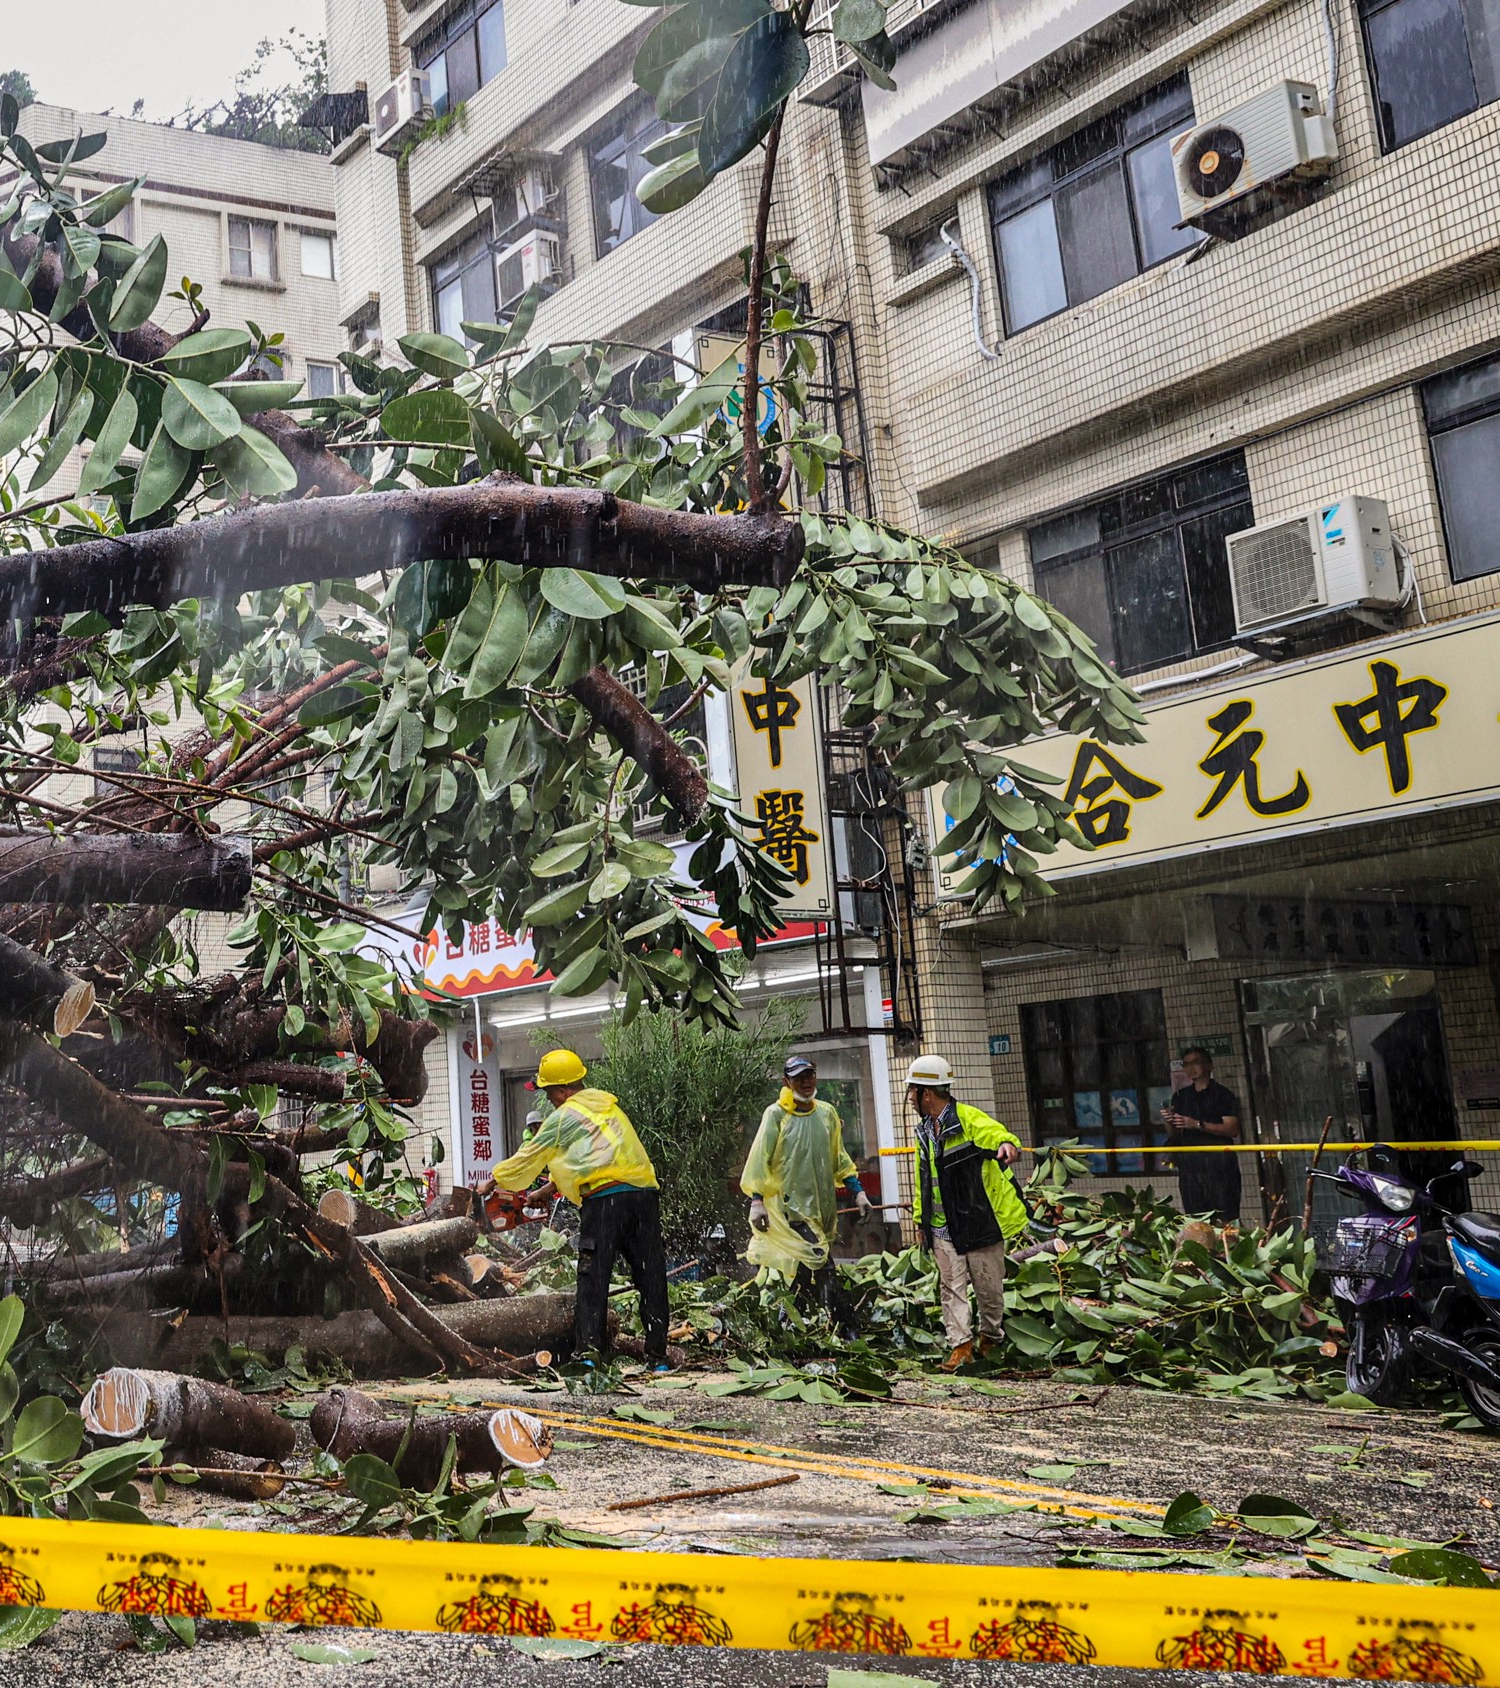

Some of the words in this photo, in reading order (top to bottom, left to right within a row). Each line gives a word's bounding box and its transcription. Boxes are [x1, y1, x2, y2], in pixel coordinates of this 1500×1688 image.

[740, 677, 819, 886] 中醫
[1063, 659, 1449, 849] 合元中
[444, 918, 534, 961] 台糖蜜
